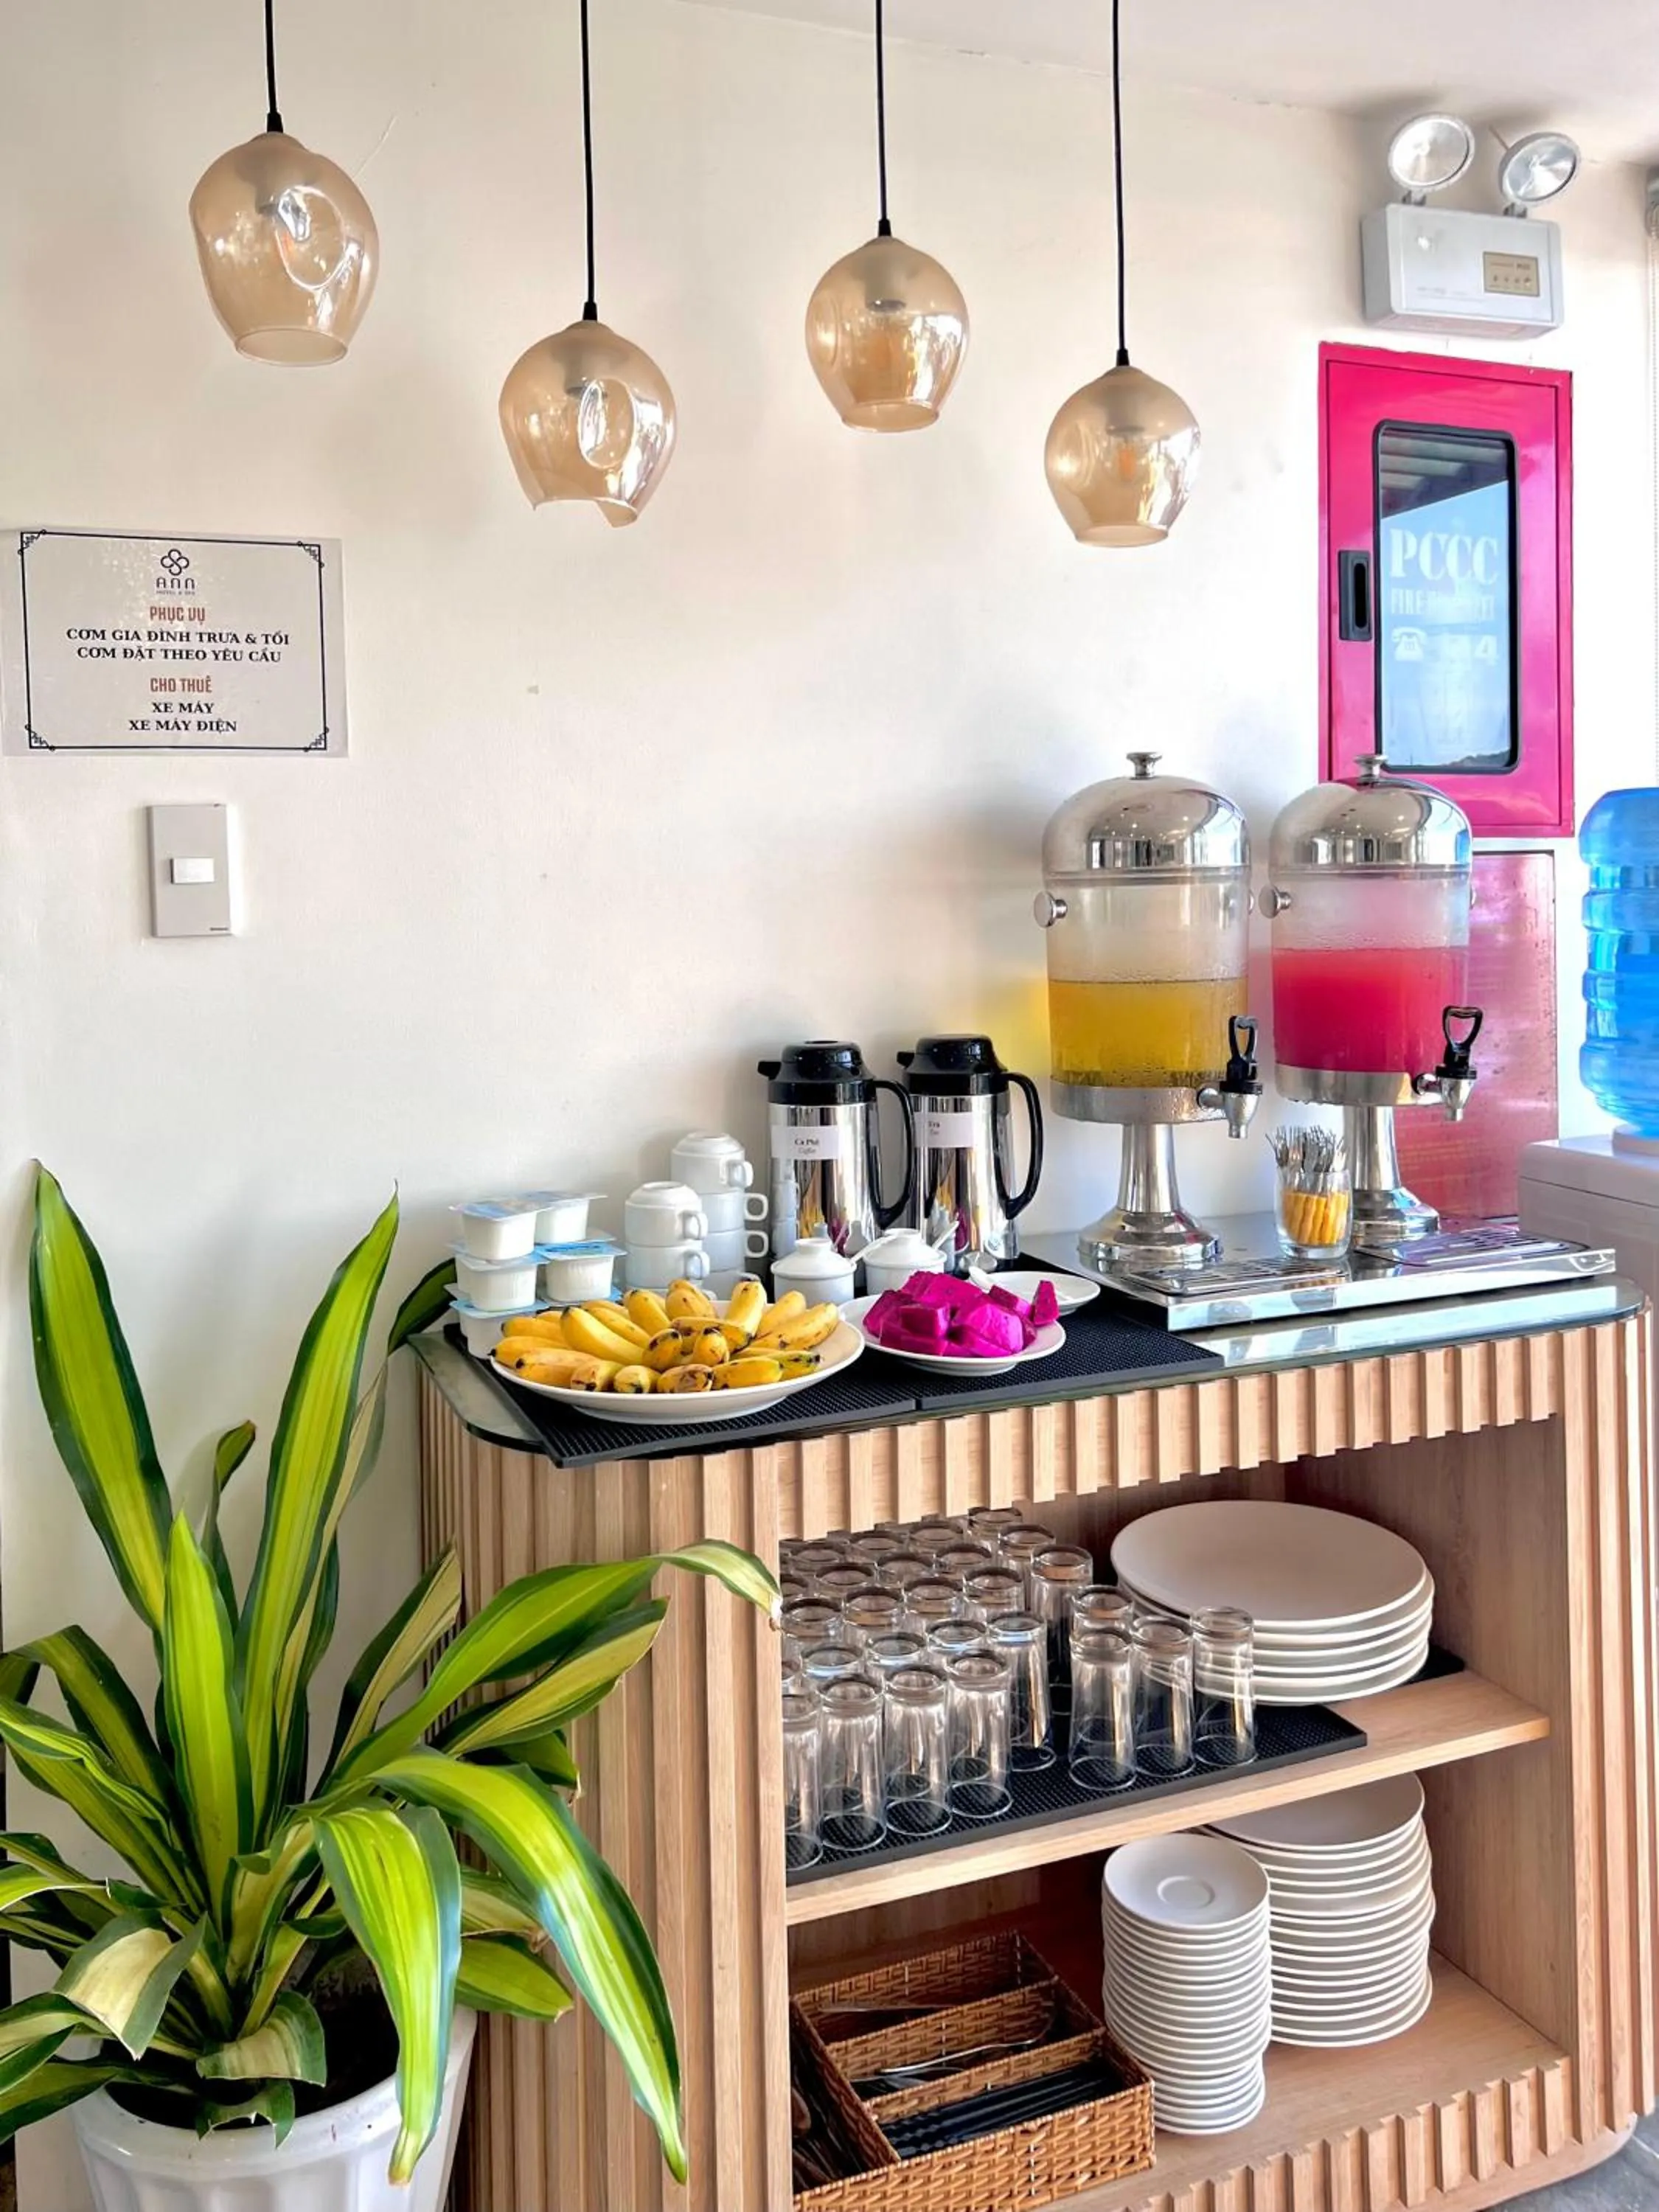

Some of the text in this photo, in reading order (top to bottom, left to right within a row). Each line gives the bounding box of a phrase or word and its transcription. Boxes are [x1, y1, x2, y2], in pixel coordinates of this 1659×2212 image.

[1390, 528, 1499, 585] PCCC
[150, 606, 184, 624] PHỤC
[66, 627, 289, 645] CƠM GIA ĐÌNH TRƯA & TỐI
[77, 647, 116, 658] CƠM
[122, 645, 155, 661] ĐẶT
[160, 648, 206, 661] THEO
[212, 648, 243, 661] YÊU
[150, 675, 212, 692] CHO THUÊ
[152, 700, 215, 714] XE MÁY
[129, 718, 237, 734] XE MÁY ĐIỆN
